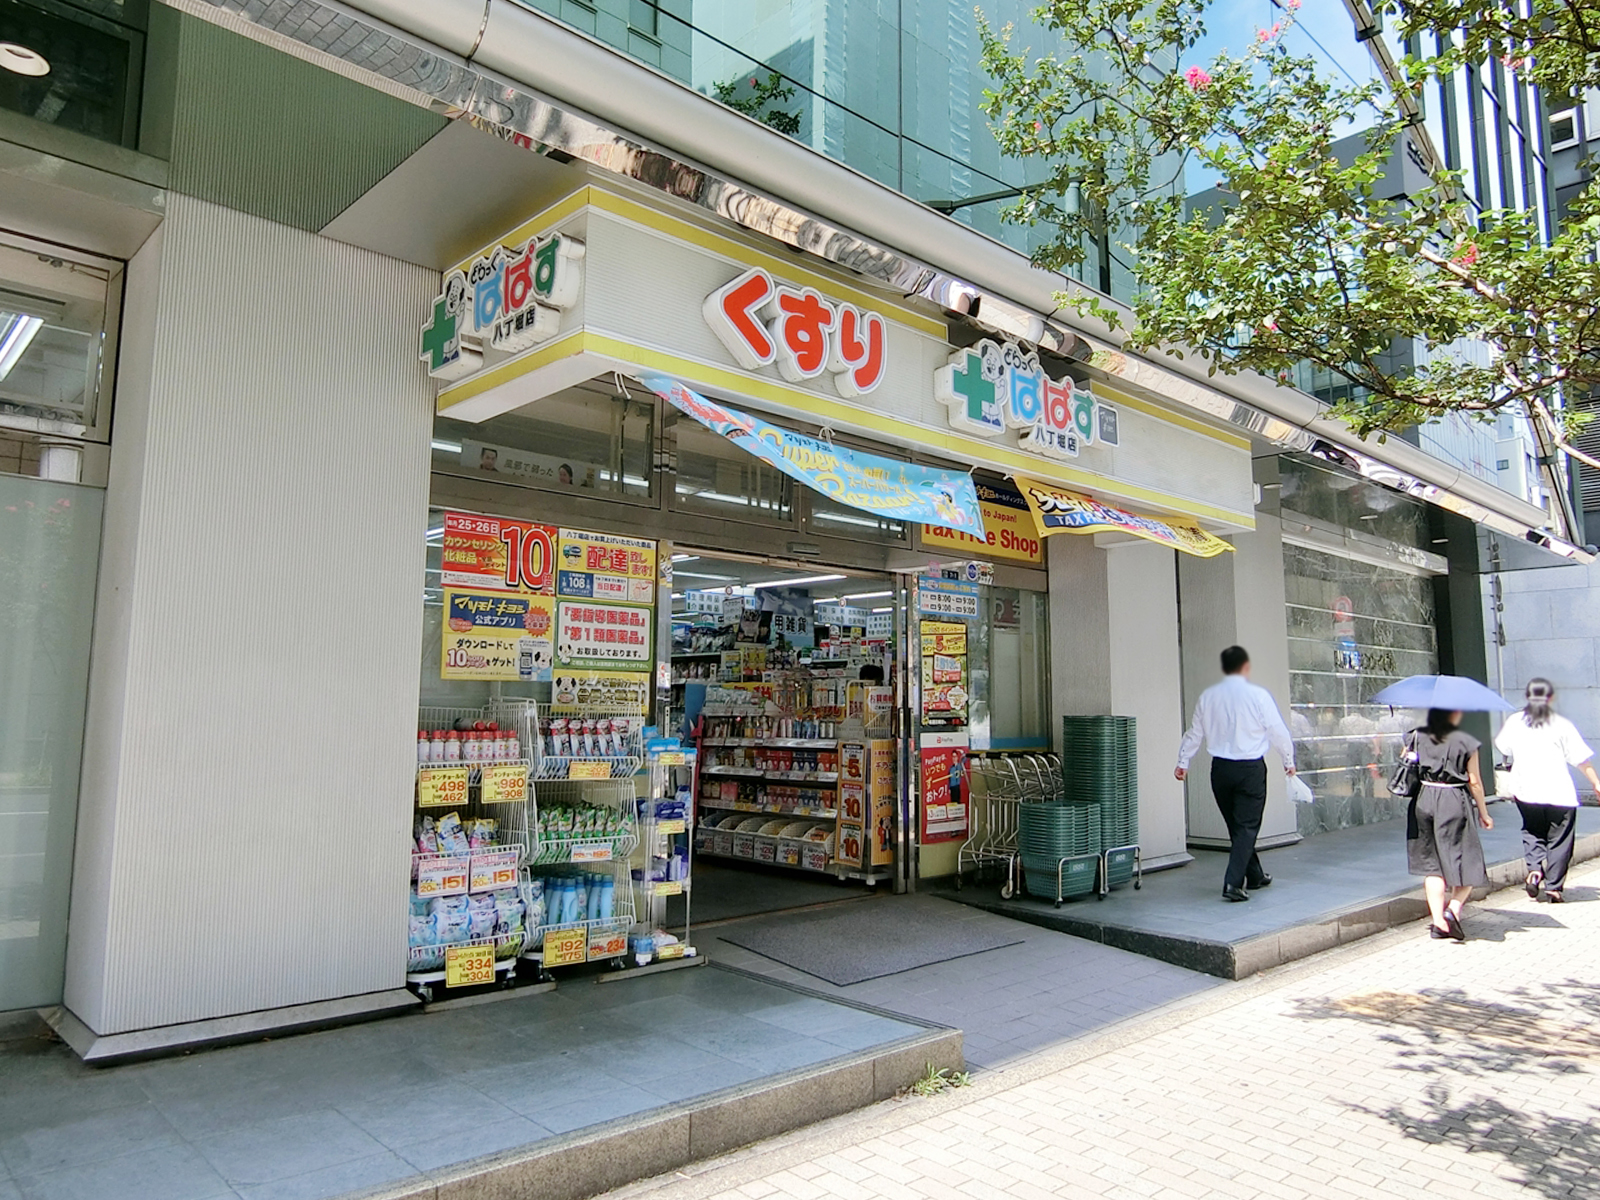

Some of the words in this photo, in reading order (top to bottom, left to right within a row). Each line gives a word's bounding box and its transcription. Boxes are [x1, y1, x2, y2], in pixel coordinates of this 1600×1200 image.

[471, 252, 499, 284] どらっく
[474, 237, 560, 331] ぱぱす
[493, 305, 536, 343] 八丁堀店
[723, 275, 882, 387] くすり
[1003, 348, 1035, 373] どらっく
[1010, 367, 1094, 439] ぱぱす
[1035, 425, 1077, 452] 八丁堀店
[982, 508, 992, 518] to
[993, 510, 1018, 523] Japan!
[1057, 515, 1082, 527] TAX
[1000, 529, 1039, 557] Shop
[445, 549, 477, 564] 化粧品
[501, 526, 554, 590] 10
[586, 545, 628, 573] 配達
[568, 577, 586, 589] 108
[454, 596, 526, 616] マツモトキヨシ
[475, 615, 516, 627] 公式アプリ
[457, 638, 514, 651] ダウンロードして
[447, 648, 468, 668] 10
[439, 781, 465, 792] 498
[500, 778, 525, 789] 980
[443, 793, 463, 801] 462
[503, 789, 523, 798] 908
[560, 940, 583, 951] 192
[606, 939, 626, 953] 234
[562, 951, 582, 961] 175
[466, 958, 492, 971] 334
[469, 971, 490, 981] 304
